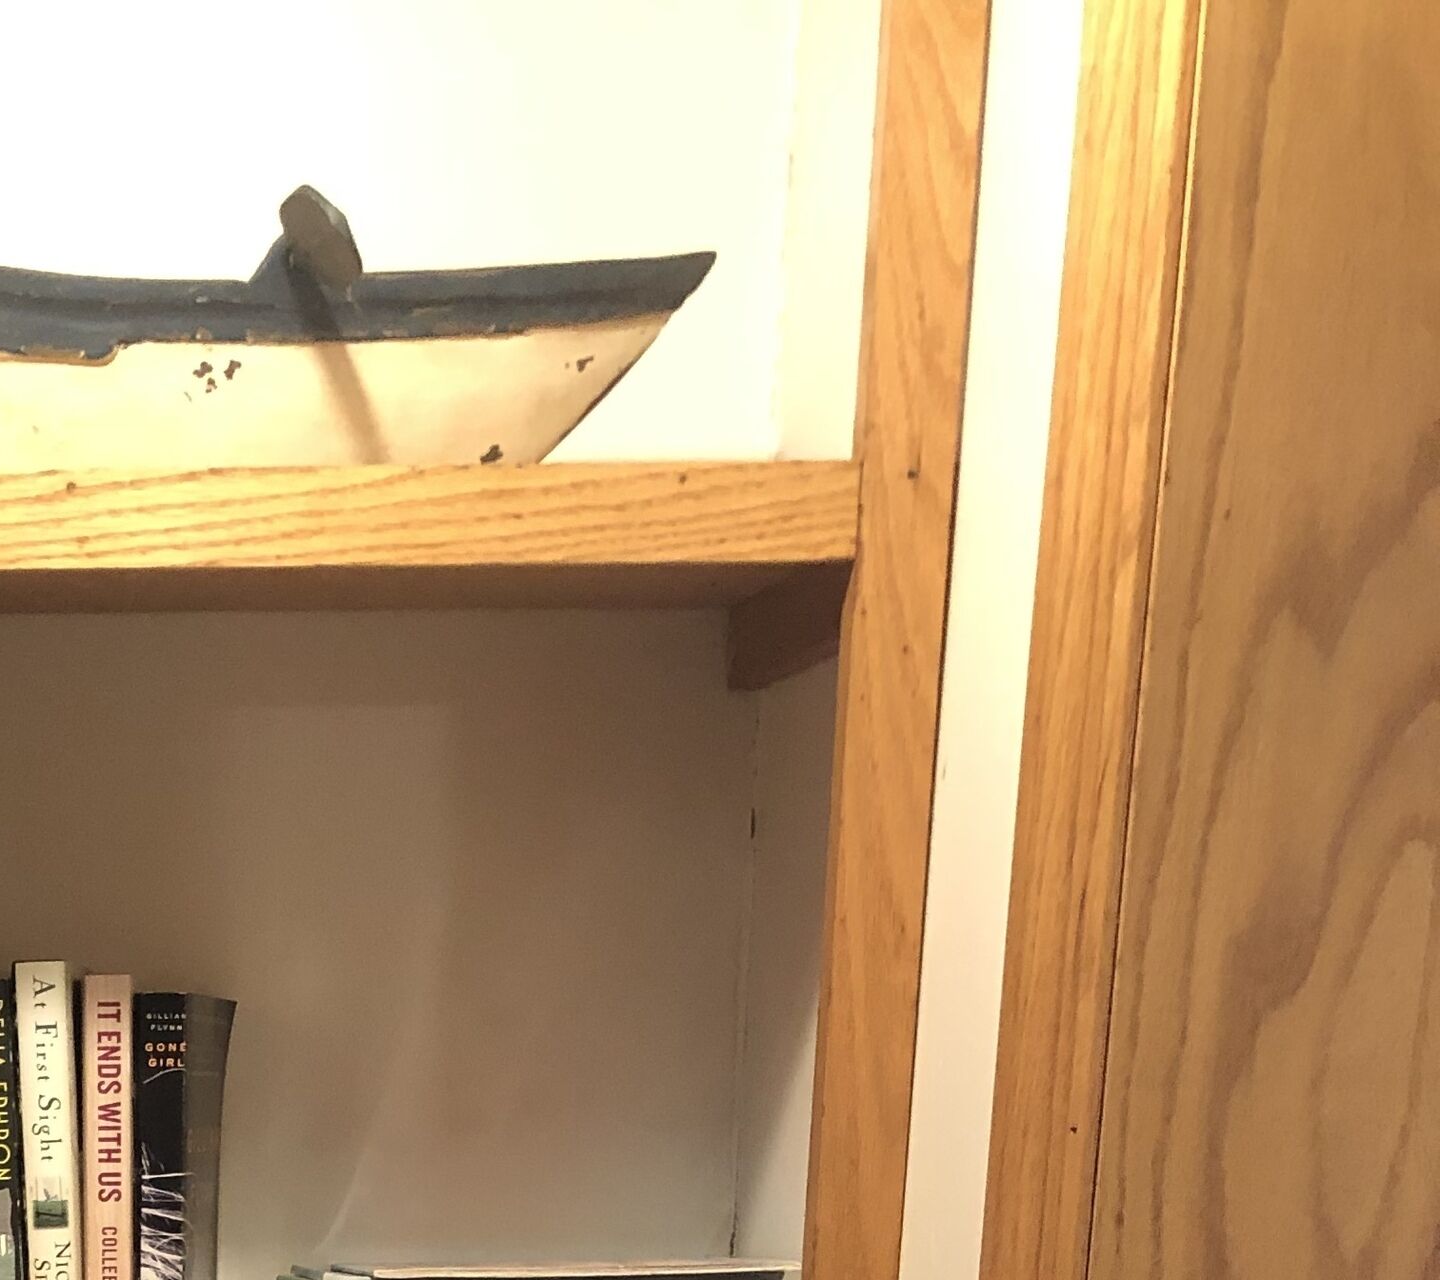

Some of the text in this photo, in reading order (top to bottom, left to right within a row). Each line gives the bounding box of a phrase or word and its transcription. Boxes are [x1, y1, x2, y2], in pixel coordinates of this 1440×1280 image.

[97, 1001, 121, 1023] IT
[97, 1031, 122, 1095] ENDS
[145, 1043, 188, 1052] GONE
[148, 1058, 185, 1068] GIRL
[31, 975, 63, 1162] At First Sight
[97, 1101, 122, 1164] WITH
[97, 1172, 122, 1203] US
